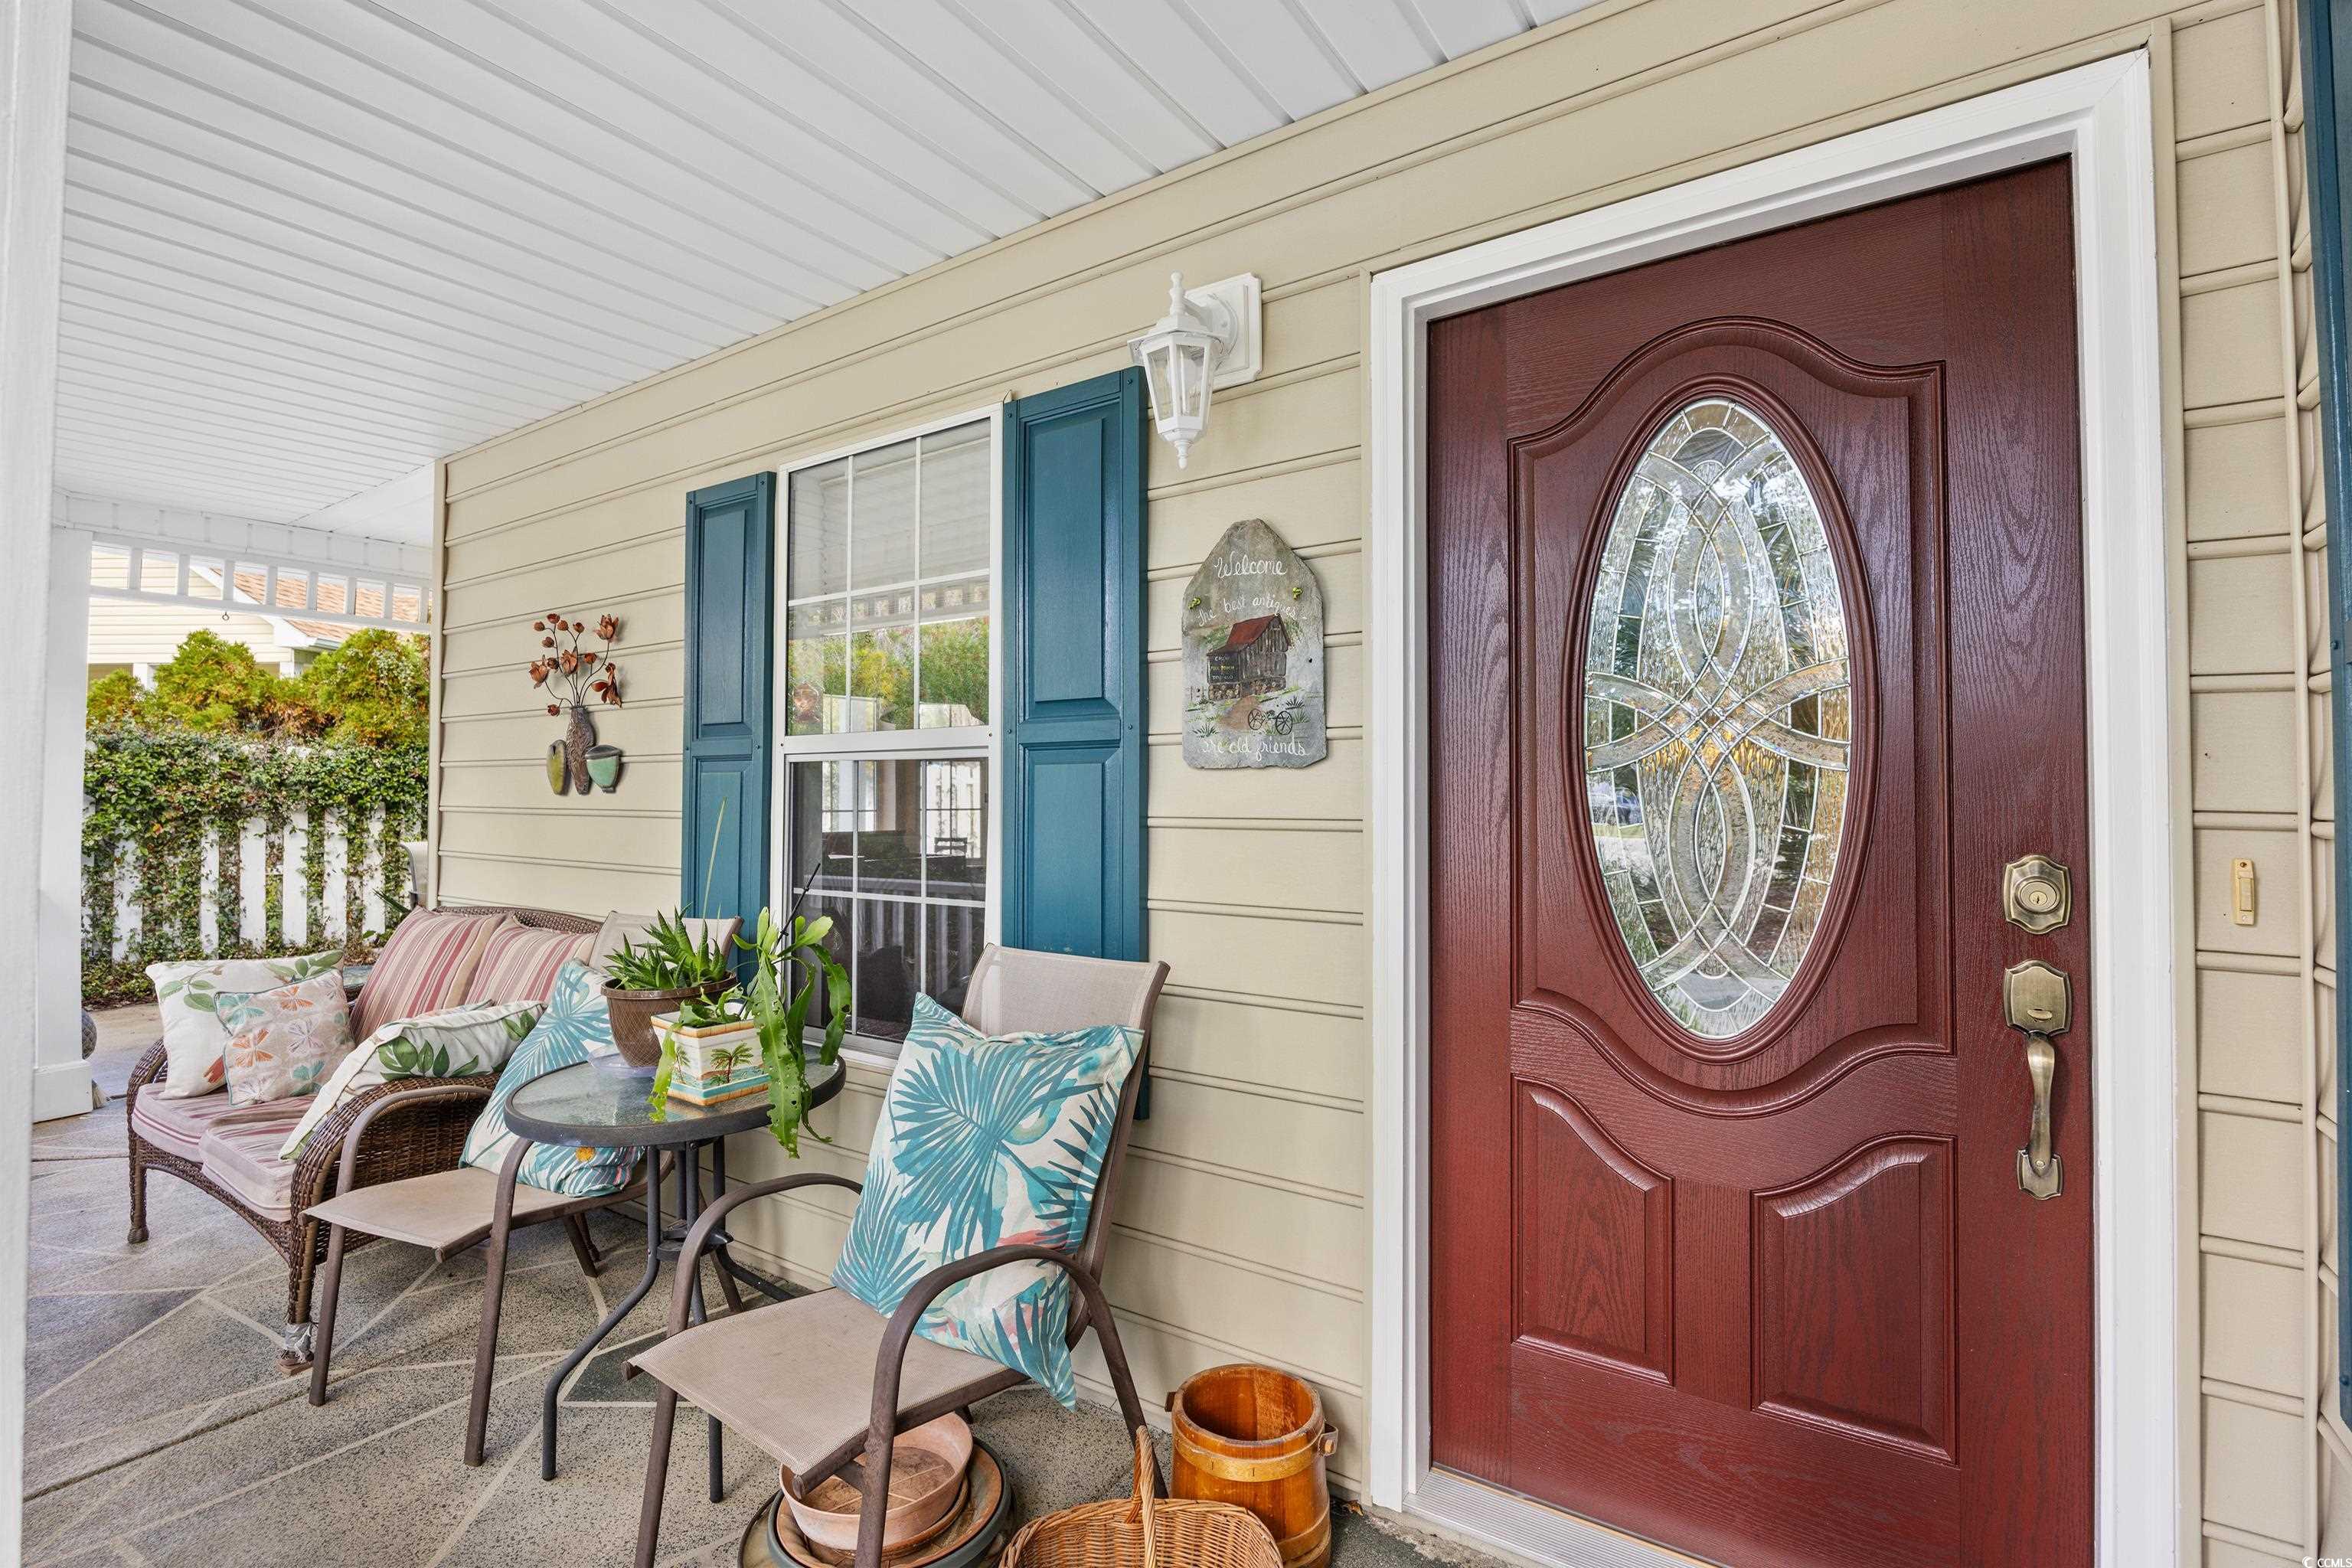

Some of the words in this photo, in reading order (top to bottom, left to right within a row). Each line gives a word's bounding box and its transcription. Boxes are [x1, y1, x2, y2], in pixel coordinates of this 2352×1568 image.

[1214, 550, 1288, 579] Welcome
[1223, 596, 1246, 613] best
[1229, 735, 1253, 754] old
[1255, 731, 1312, 762] friends
